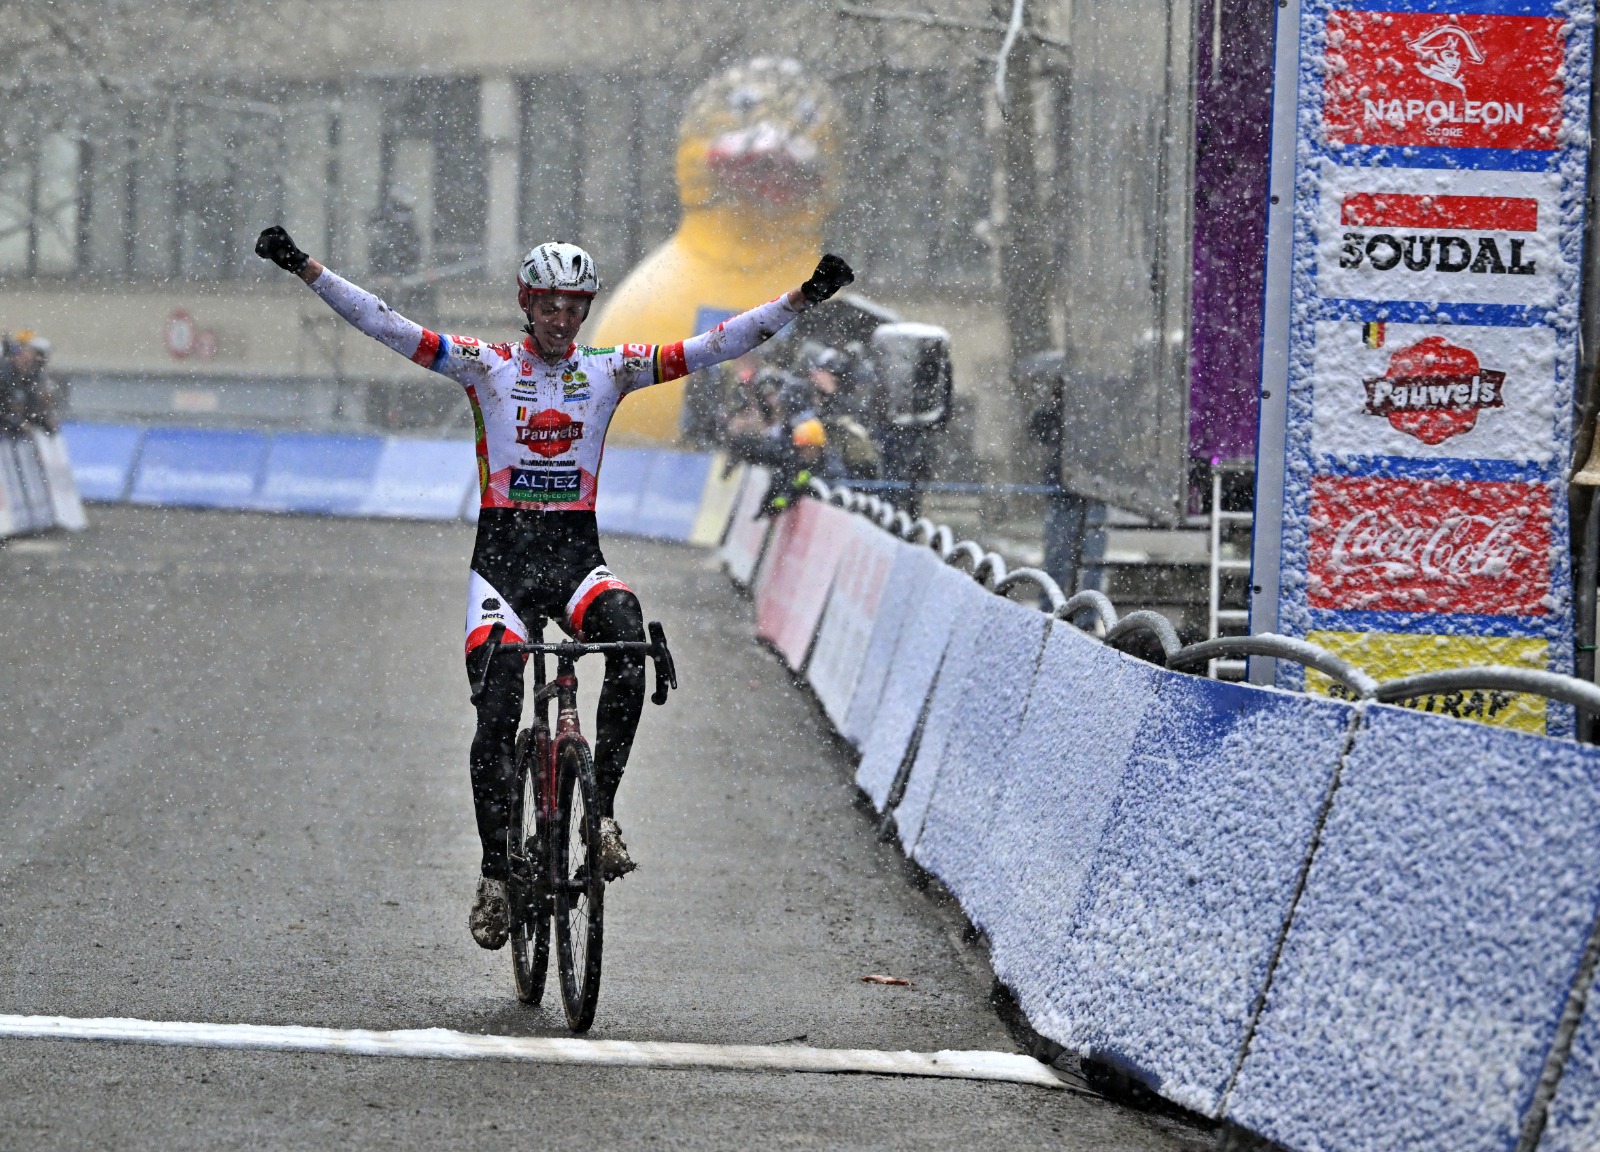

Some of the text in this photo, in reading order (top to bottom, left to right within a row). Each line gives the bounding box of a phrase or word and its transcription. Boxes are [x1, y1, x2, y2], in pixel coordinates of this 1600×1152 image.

[1364, 98, 1523, 125] NAPOLEON
[1425, 127, 1463, 137] SCORE
[1339, 232, 1536, 275] SOUDAL
[1373, 376, 1496, 407] Pauwels
[521, 425, 579, 441] Pauwels
[513, 474, 578, 489] ALTEZ
[481, 612, 505, 620] Hertz
